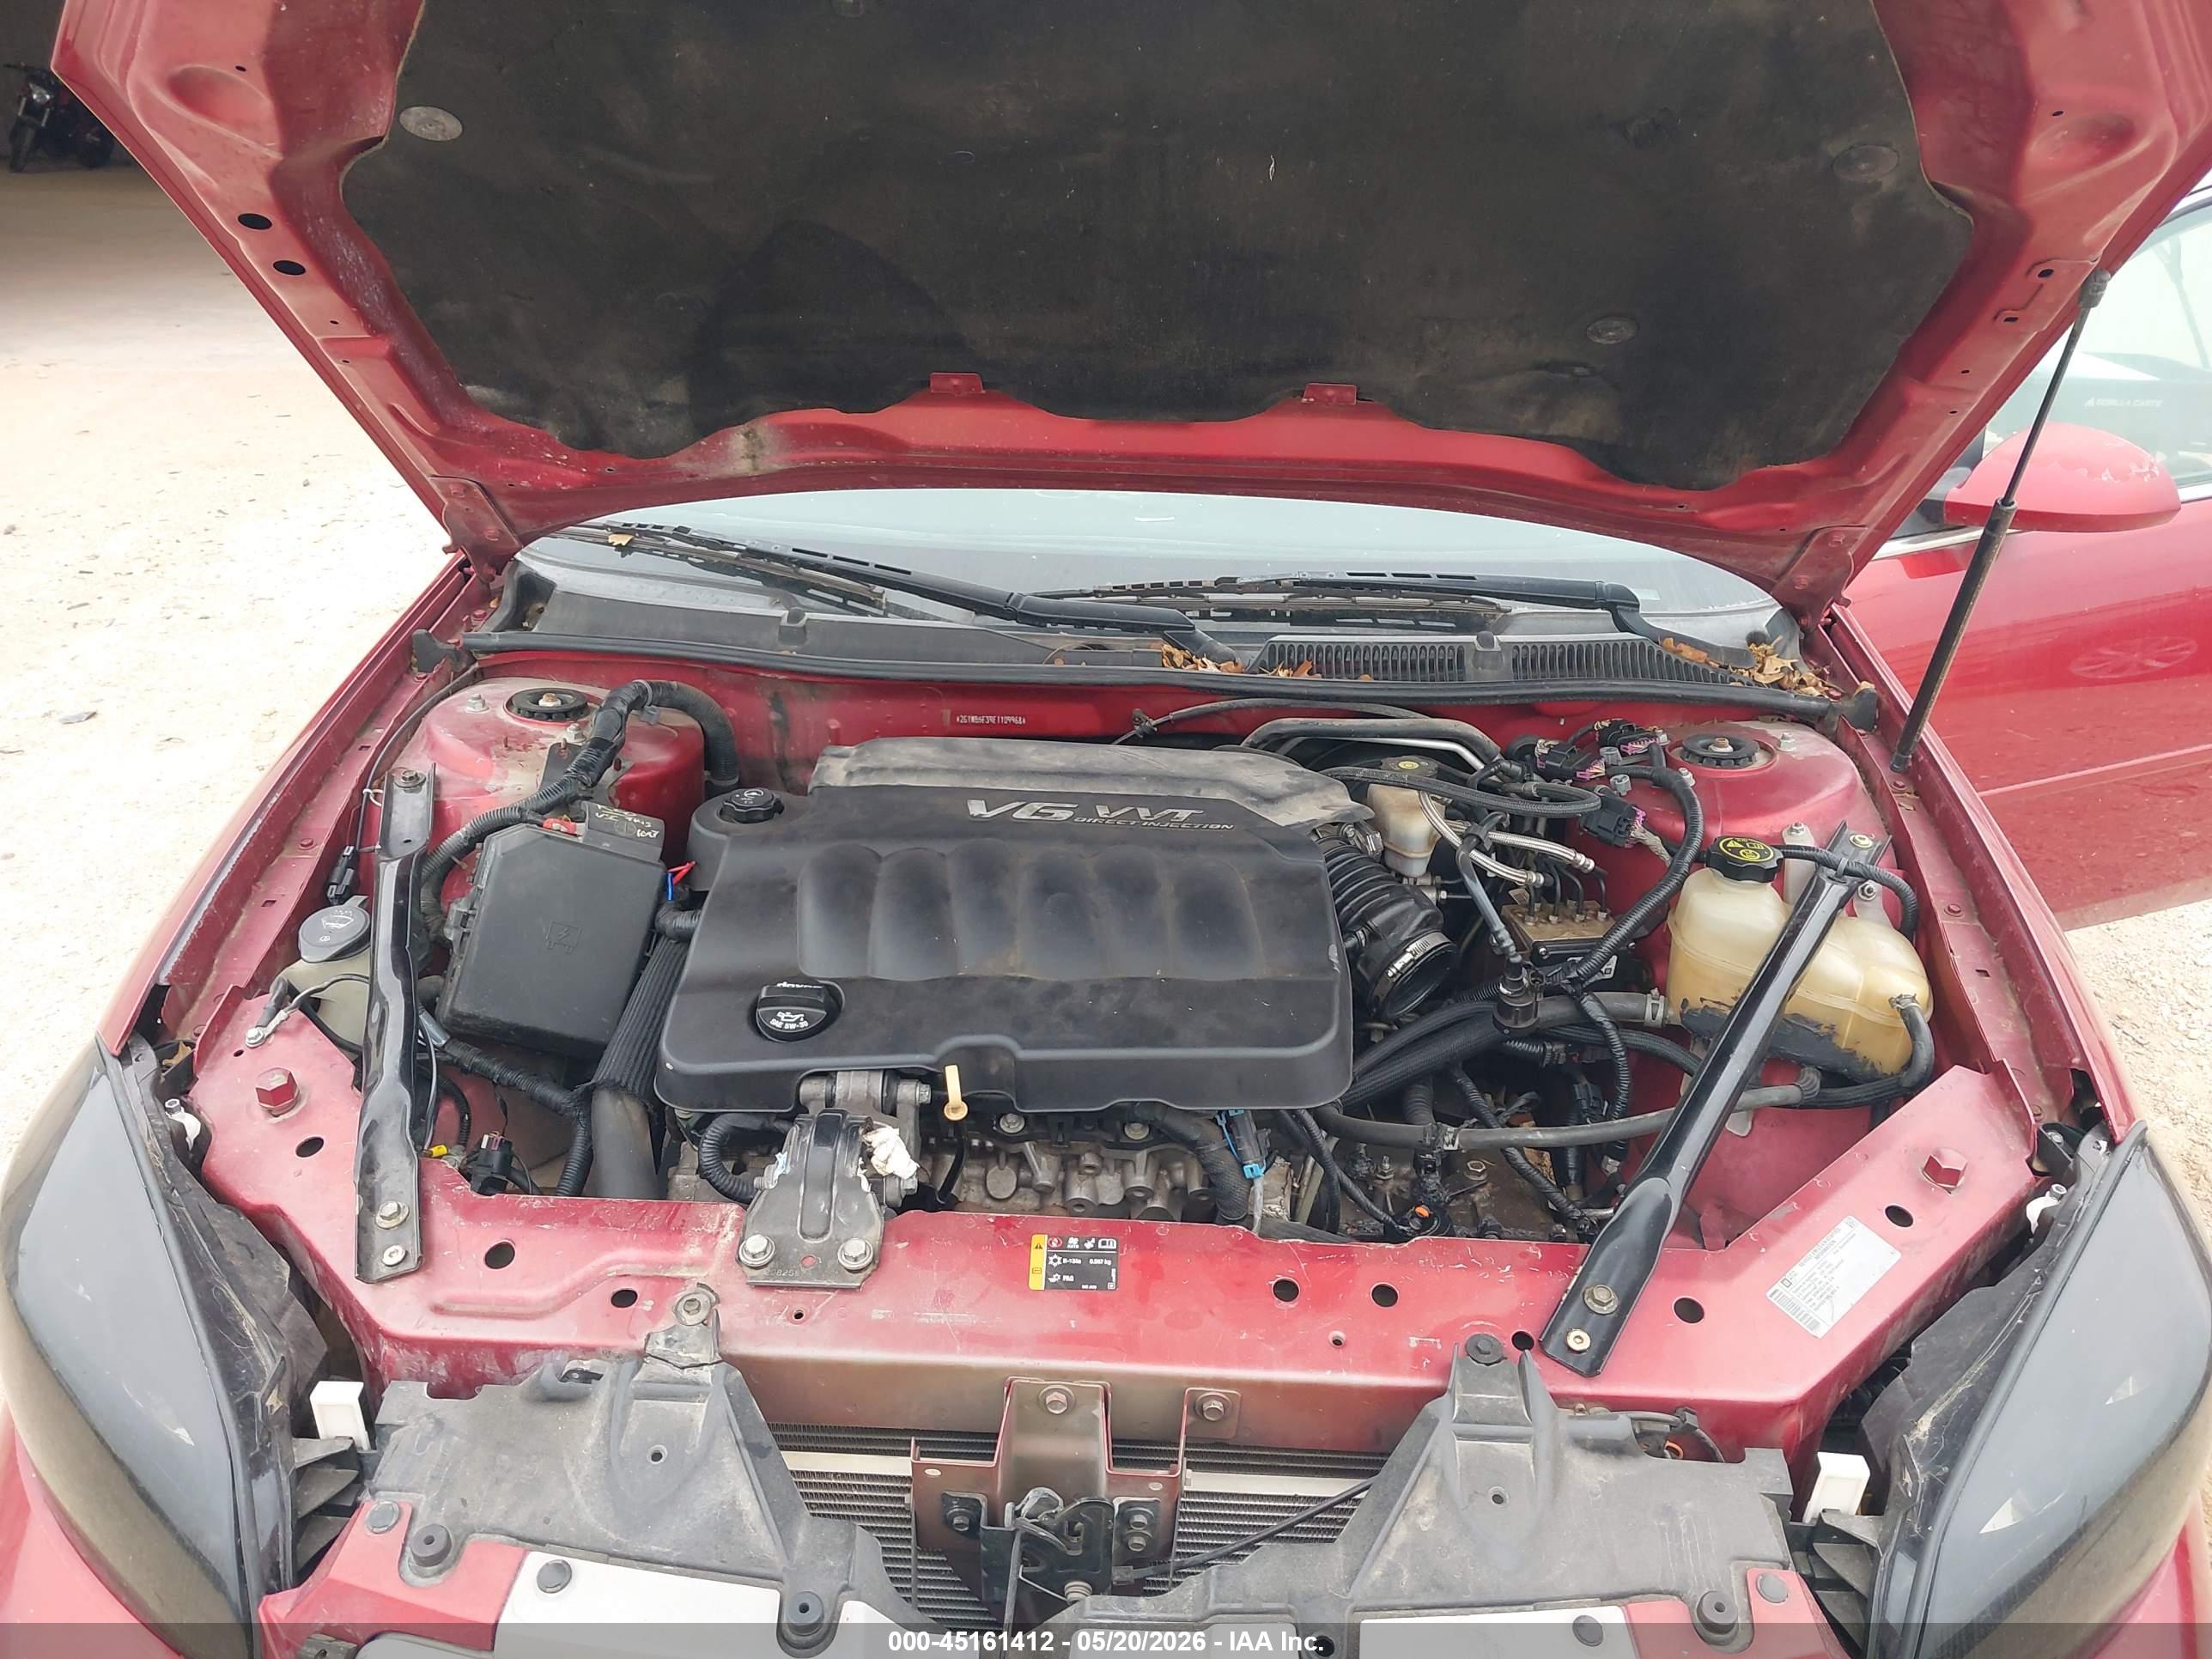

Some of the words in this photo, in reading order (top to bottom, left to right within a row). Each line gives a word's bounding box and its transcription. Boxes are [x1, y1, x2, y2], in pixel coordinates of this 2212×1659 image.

[967, 799, 1079, 821] V6
[1095, 804, 1204, 822] VVT
[1073, 817, 1138, 827] DIRECT
[1141, 819, 1235, 830] INJECTION
[769, 1018, 784, 1029] SAE
[784, 1019, 809, 1030] 5W-30
